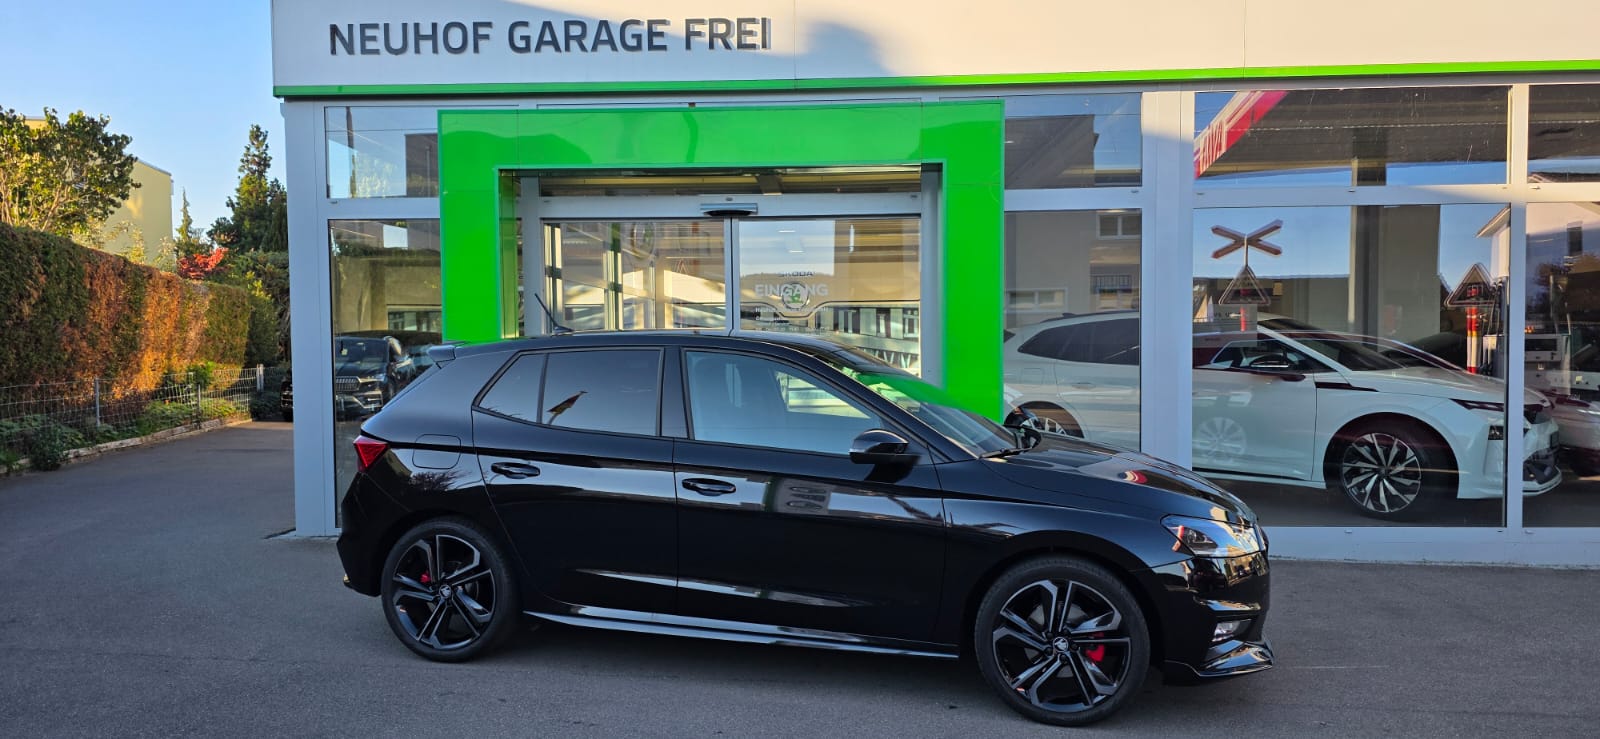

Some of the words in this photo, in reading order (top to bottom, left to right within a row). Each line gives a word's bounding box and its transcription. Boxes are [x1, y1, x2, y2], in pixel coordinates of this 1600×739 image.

[329, 21, 492, 56] NEUHOF
[507, 18, 669, 53] GARAGE
[684, 17, 772, 51] FREI
[755, 284, 828, 297] EINGANG
